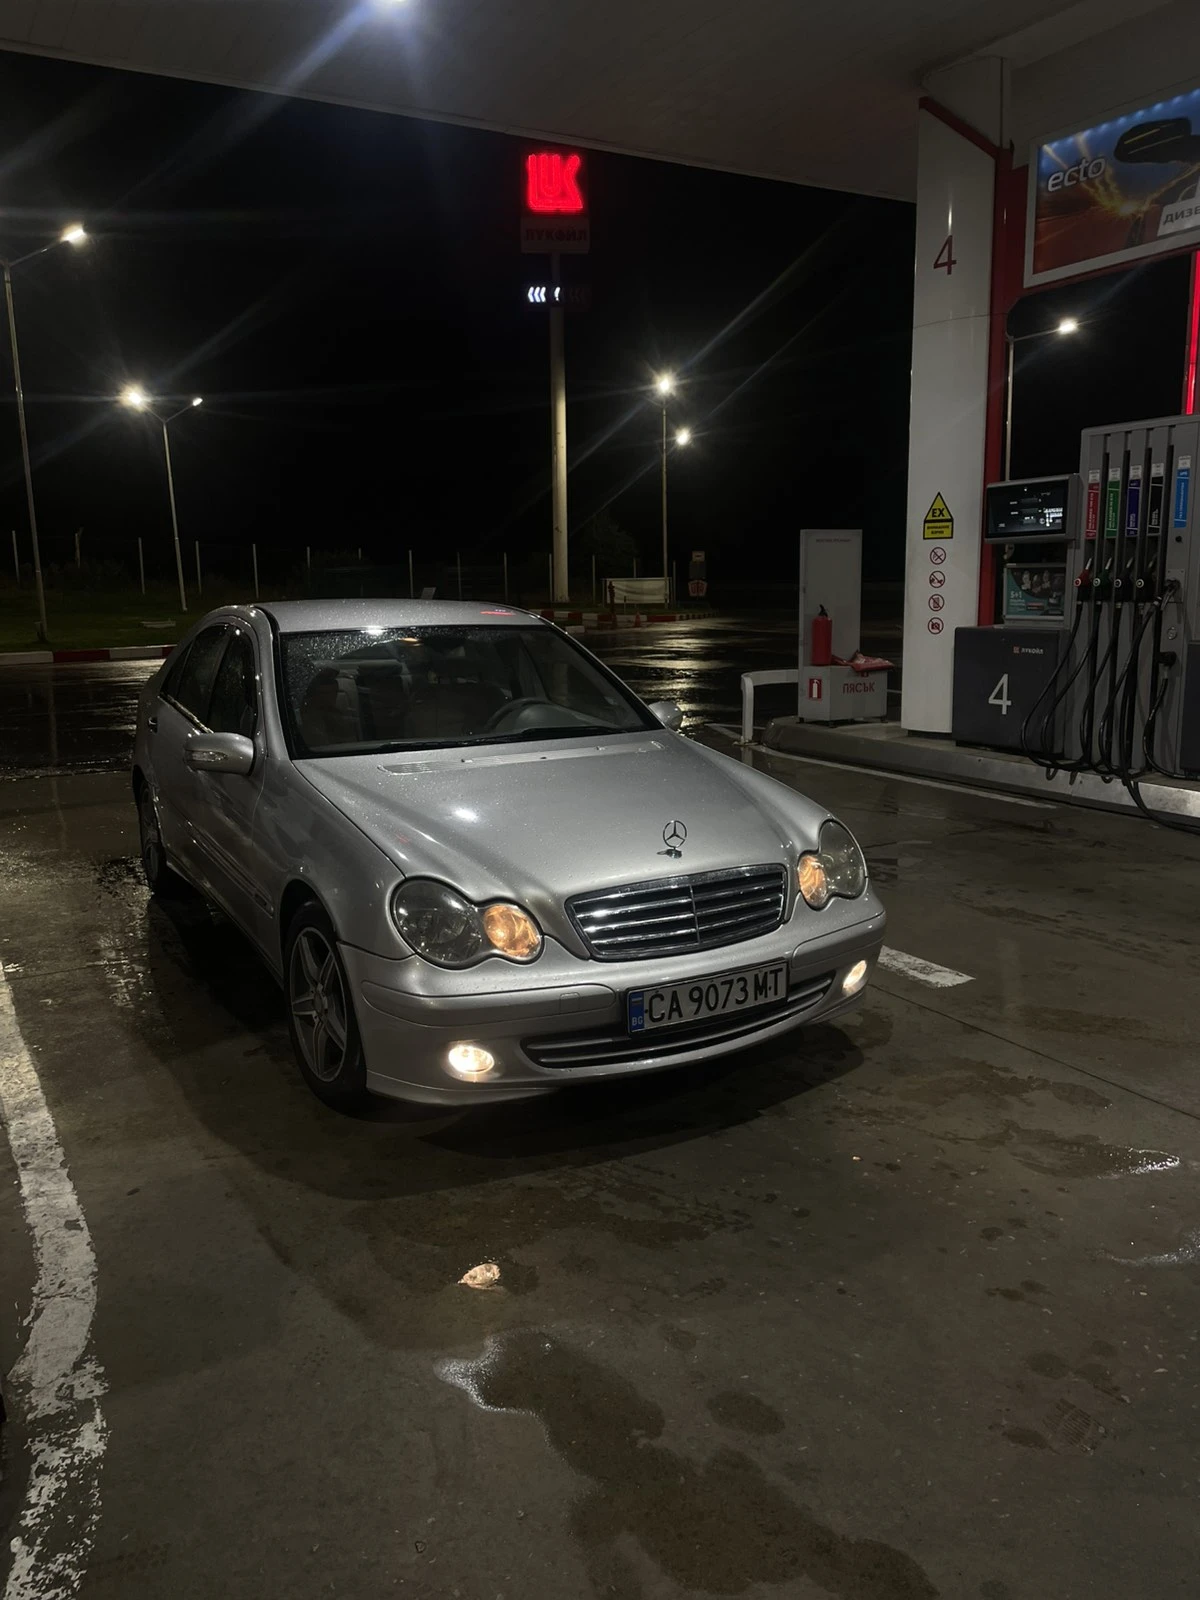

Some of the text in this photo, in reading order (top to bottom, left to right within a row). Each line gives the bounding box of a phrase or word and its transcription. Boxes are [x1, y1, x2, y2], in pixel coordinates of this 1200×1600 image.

[1047, 156, 1107, 192] ecto
[933, 235, 957, 275] 4
[931, 507, 945, 518] EX
[842, 681, 876, 694] ПЯСЪК
[988, 673, 1012, 715] 4
[648, 968, 783, 1023] CA 9073 MT
[631, 1015, 644, 1026] BG
